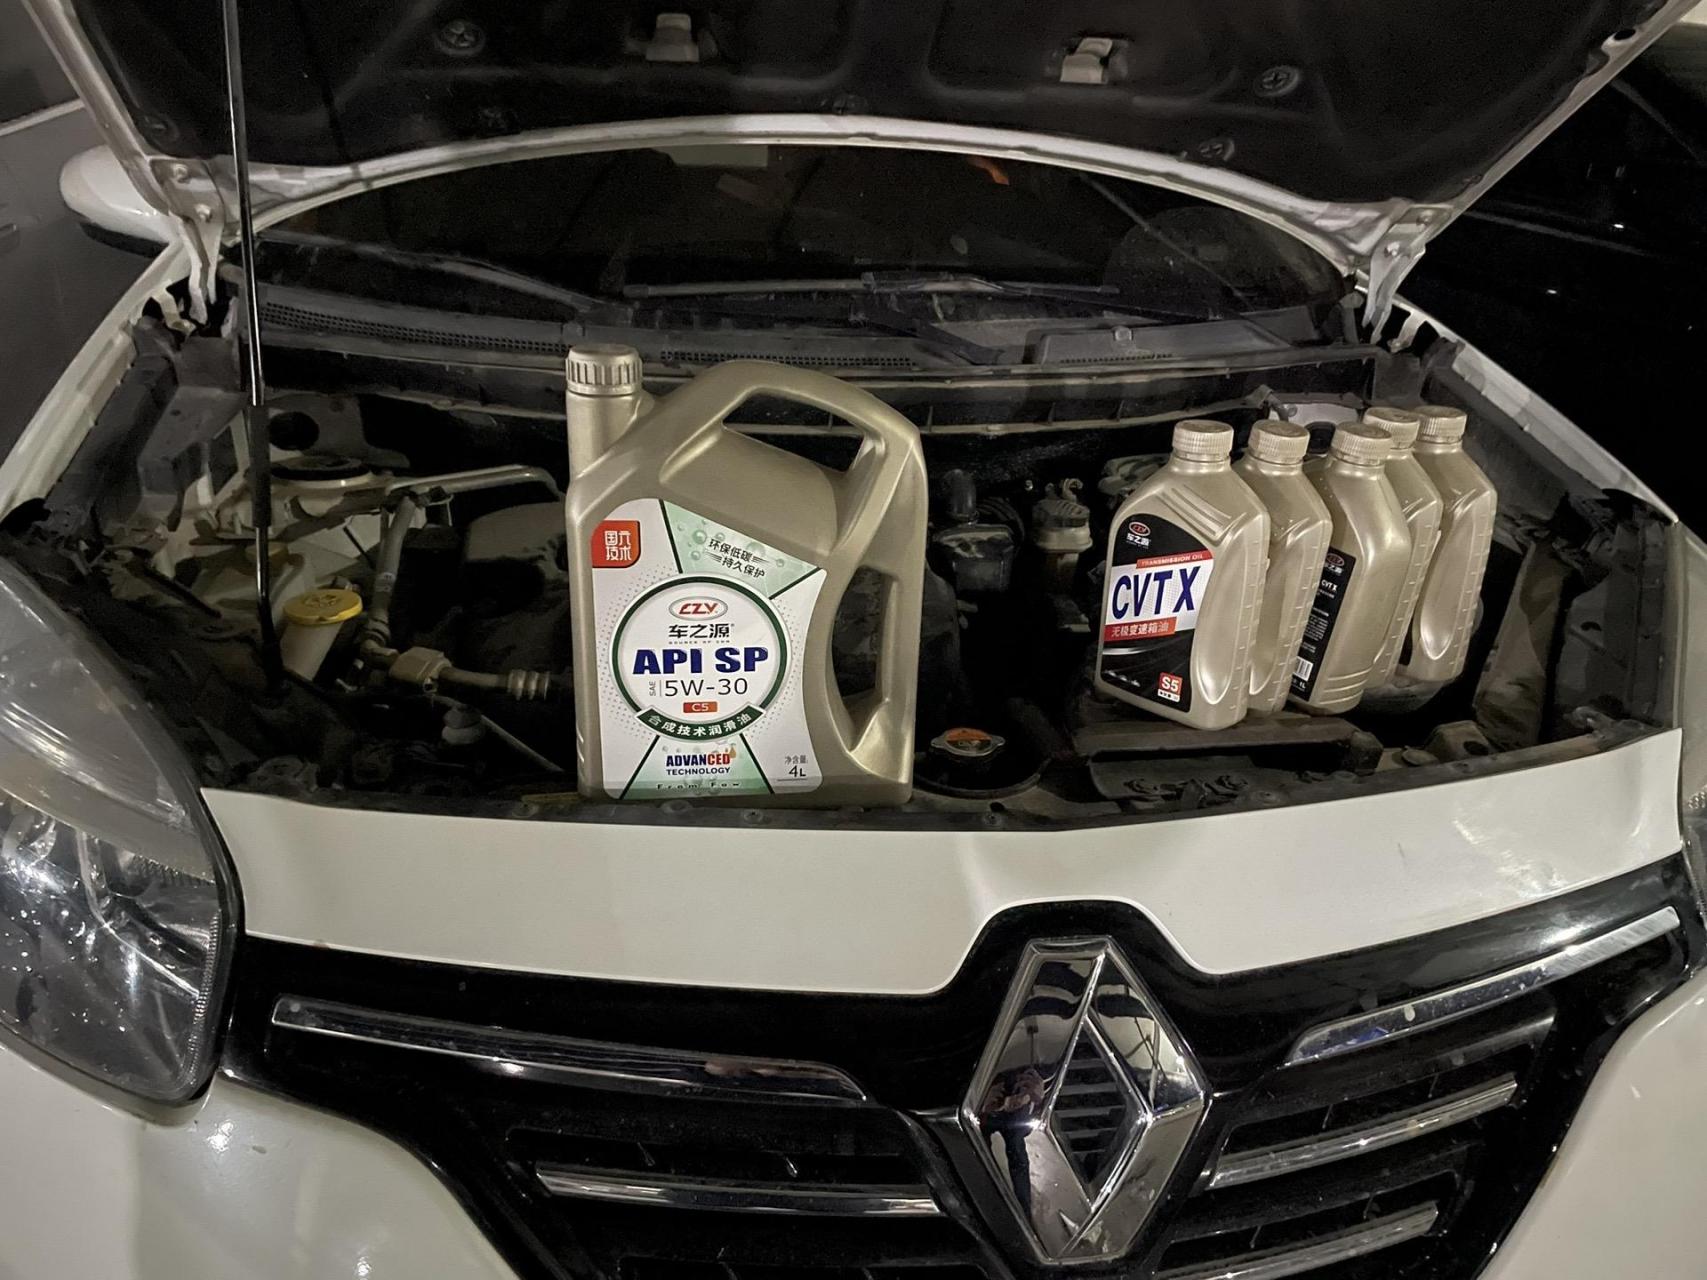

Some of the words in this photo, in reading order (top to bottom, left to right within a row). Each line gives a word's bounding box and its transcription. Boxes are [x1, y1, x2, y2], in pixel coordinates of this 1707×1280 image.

[605, 546, 632, 561] 技术
[708, 538, 753, 563] 环保低碳
[721, 556, 766, 579] 持久保护
[1112, 569, 1173, 620] CVT
[1172, 565, 1201, 613] X
[668, 623, 731, 639] 车之源
[1111, 621, 1170, 638] 无极变速箱油
[632, 648, 703, 675] API
[714, 646, 769, 673] SP
[648, 680, 657, 697] SAE
[664, 677, 748, 697] 5W-30
[1161, 675, 1180, 693] S5
[691, 702, 709, 712] C5
[648, 713, 752, 737] 合成技术润滑油
[665, 753, 731, 768] ADVANCED
[666, 767, 731, 776] TECHNOLOGY
[788, 765, 807, 777] 4L
